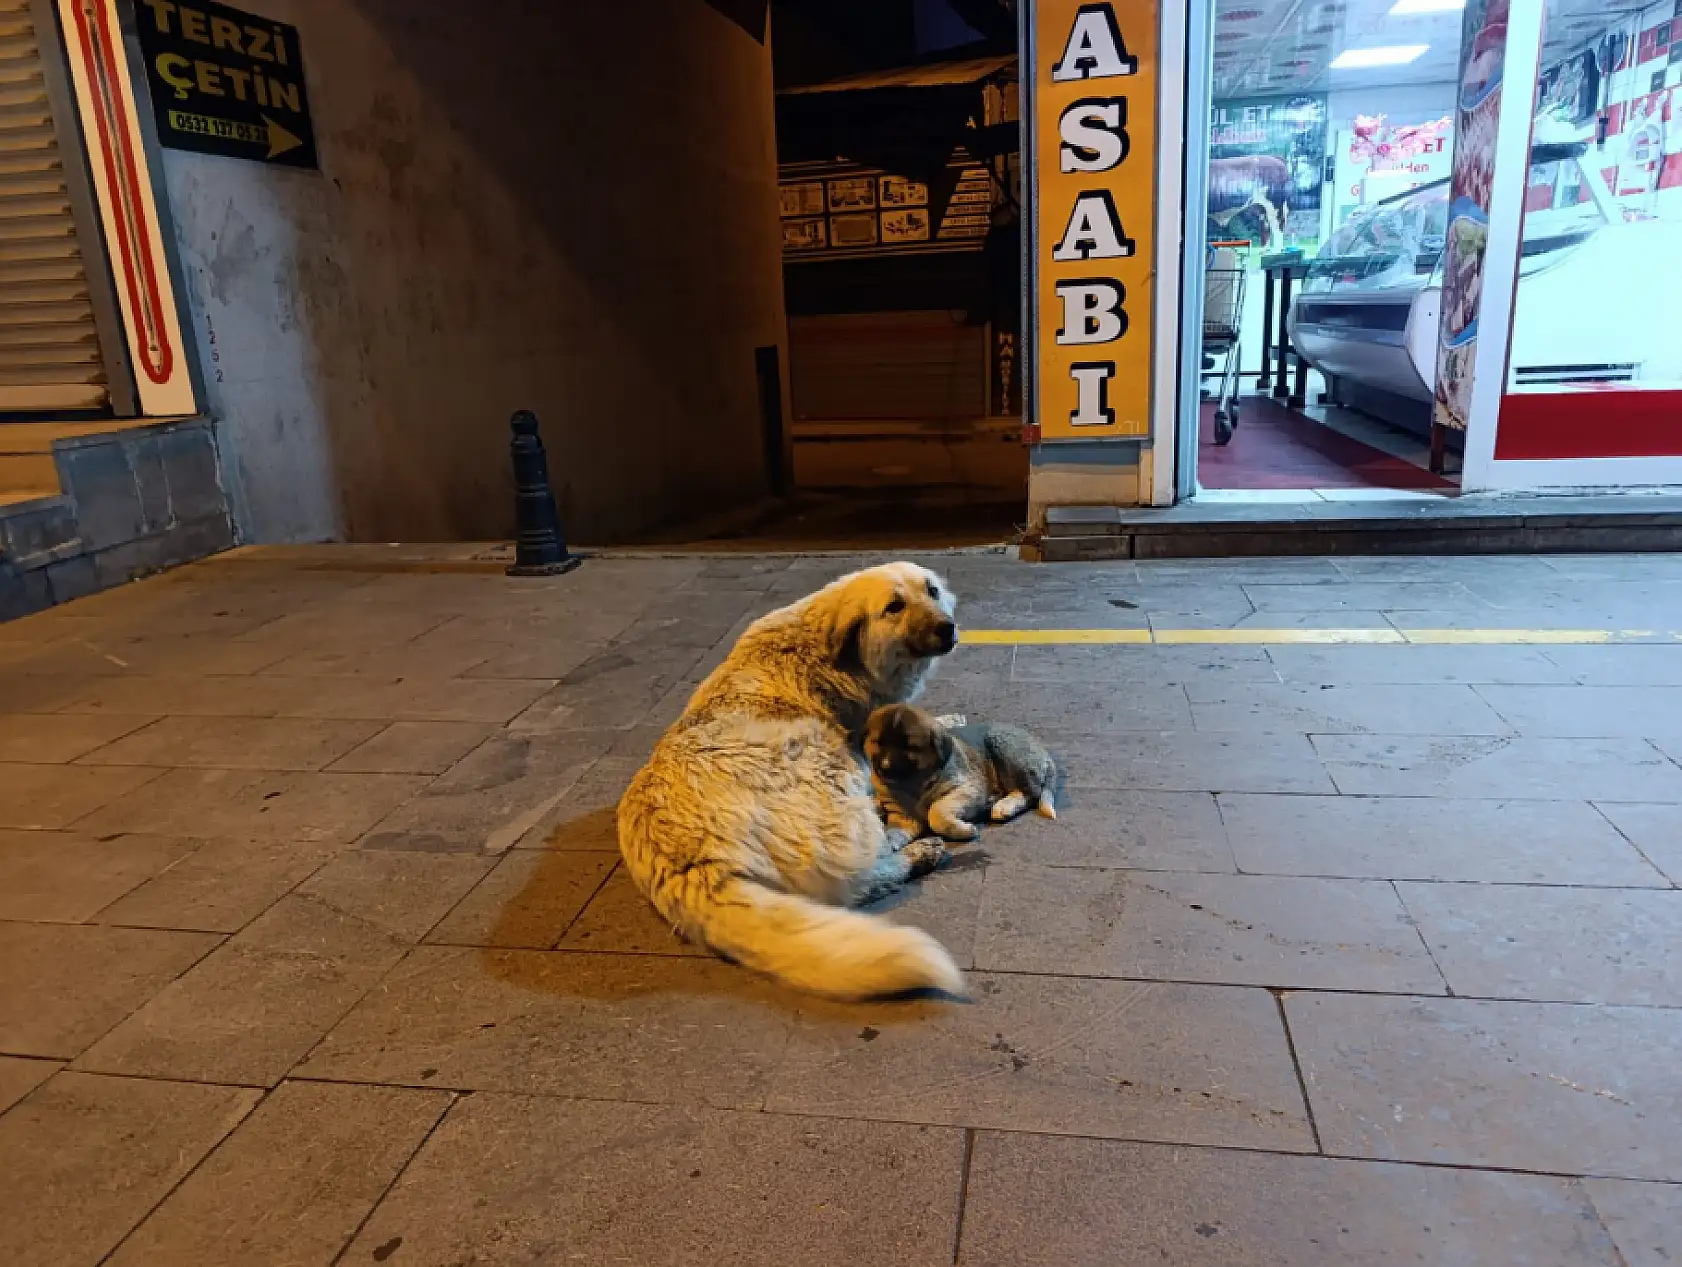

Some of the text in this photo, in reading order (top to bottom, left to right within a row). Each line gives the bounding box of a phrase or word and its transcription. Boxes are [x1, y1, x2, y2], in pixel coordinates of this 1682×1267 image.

[144, 0, 288, 65] TERZİ
[156, 52, 301, 112] ÇETİN
[1052, 2, 1138, 426] ASABI
